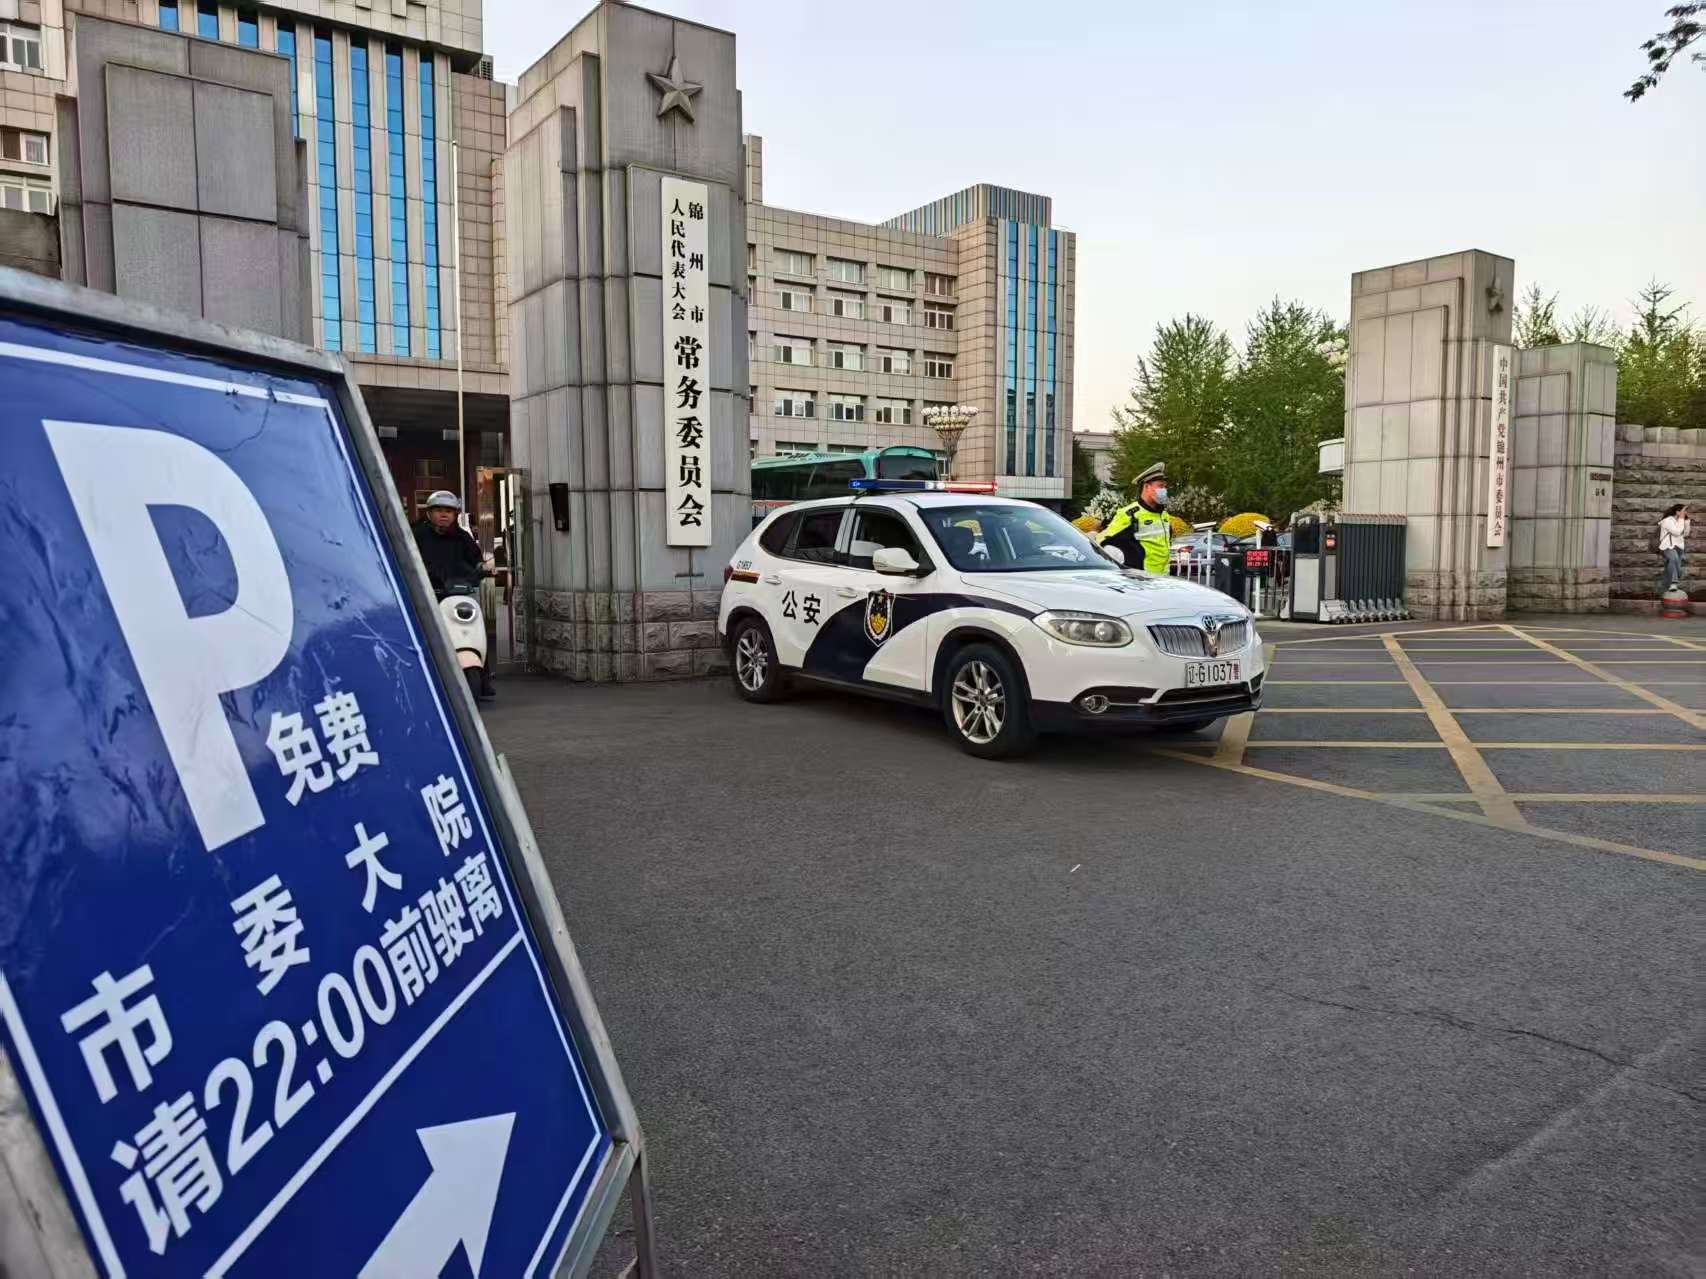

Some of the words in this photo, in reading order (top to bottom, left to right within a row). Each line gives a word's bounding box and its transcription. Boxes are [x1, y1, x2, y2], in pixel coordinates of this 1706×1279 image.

[670, 198, 686, 321] 人民代表大会
[688, 202, 704, 324] 锦州市
[674, 335, 704, 527] 常务委员会
[42, 419, 294, 852] P
[782, 589, 821, 626] 公安
[266, 691, 380, 806] 免费
[60, 775, 473, 1104] 市委大院
[110, 852, 503, 1256] 请22:00前驶离
